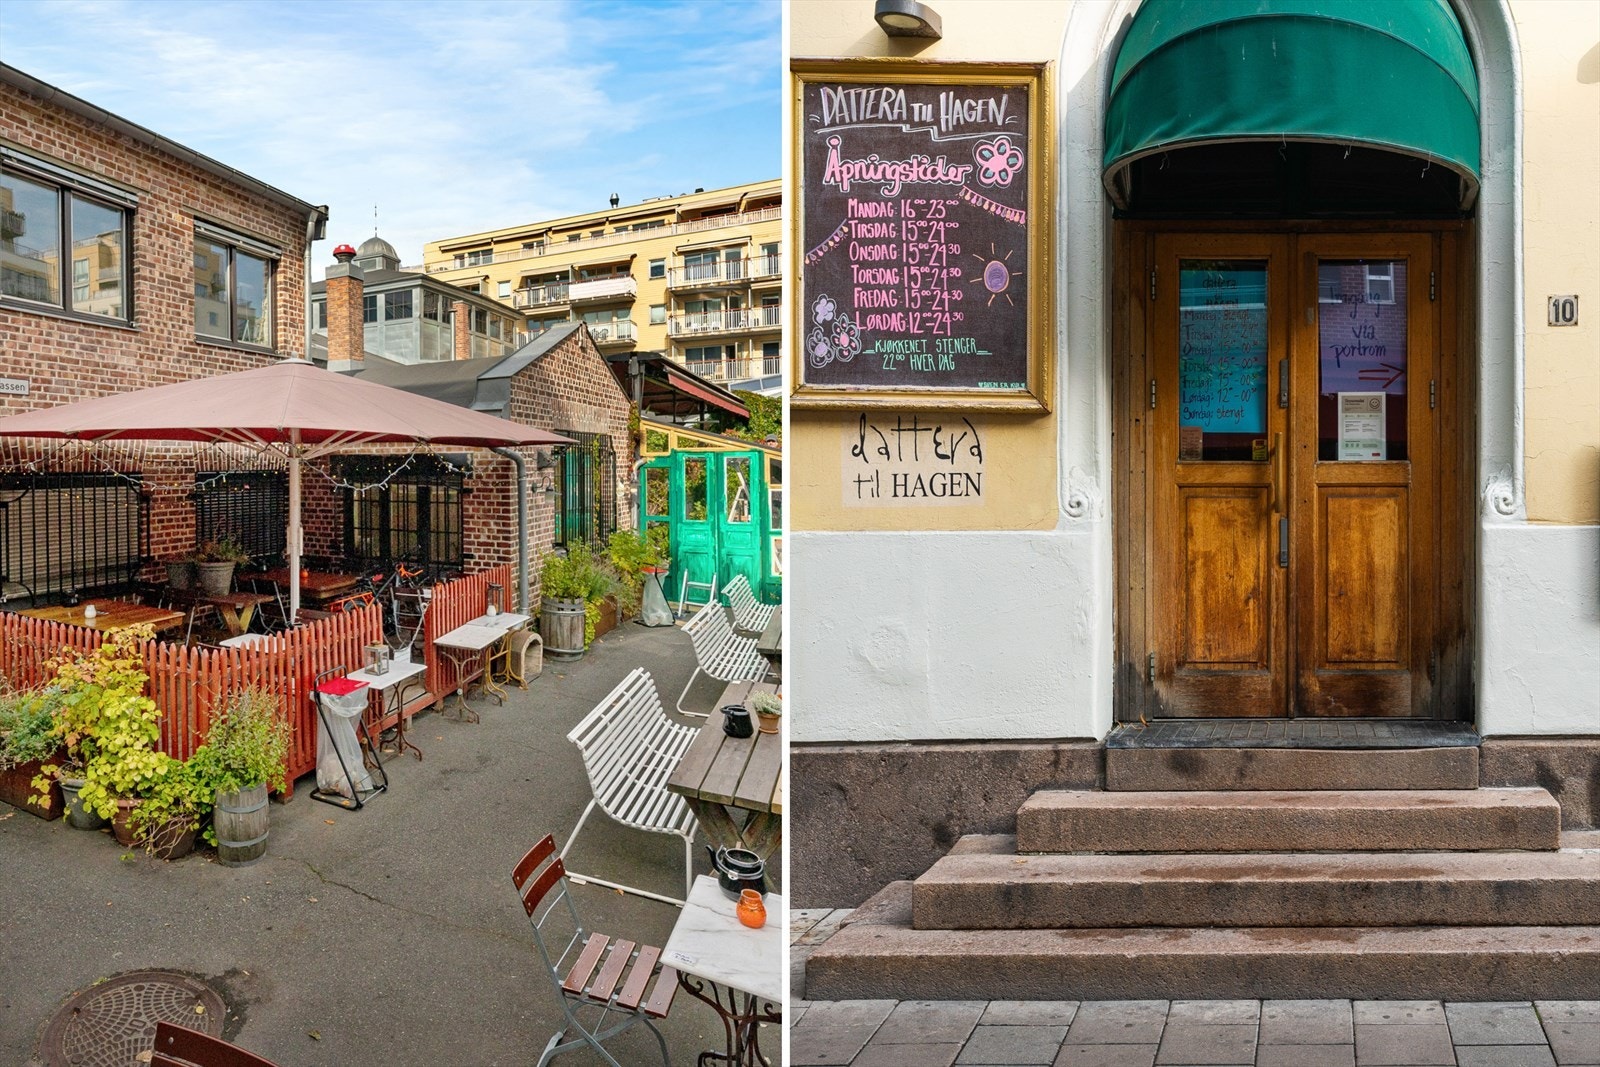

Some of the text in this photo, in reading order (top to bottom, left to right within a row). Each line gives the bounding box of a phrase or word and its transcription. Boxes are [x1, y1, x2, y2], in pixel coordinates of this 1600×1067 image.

[820, 86, 1009, 132] DATTERA TIL HAGEN
[1552, 299, 1574, 322] 10
[1351, 319, 1376, 340] via
[875, 338, 977, 354] KJØKKENET STENGER
[1328, 340, 1386, 368] portrom
[910, 354, 936, 371] HVER
[938, 354, 955, 370] DAG
[0, 382, 26, 392] assen
[852, 412, 982, 465] dattera
[853, 469, 982, 499] til HAGEN
